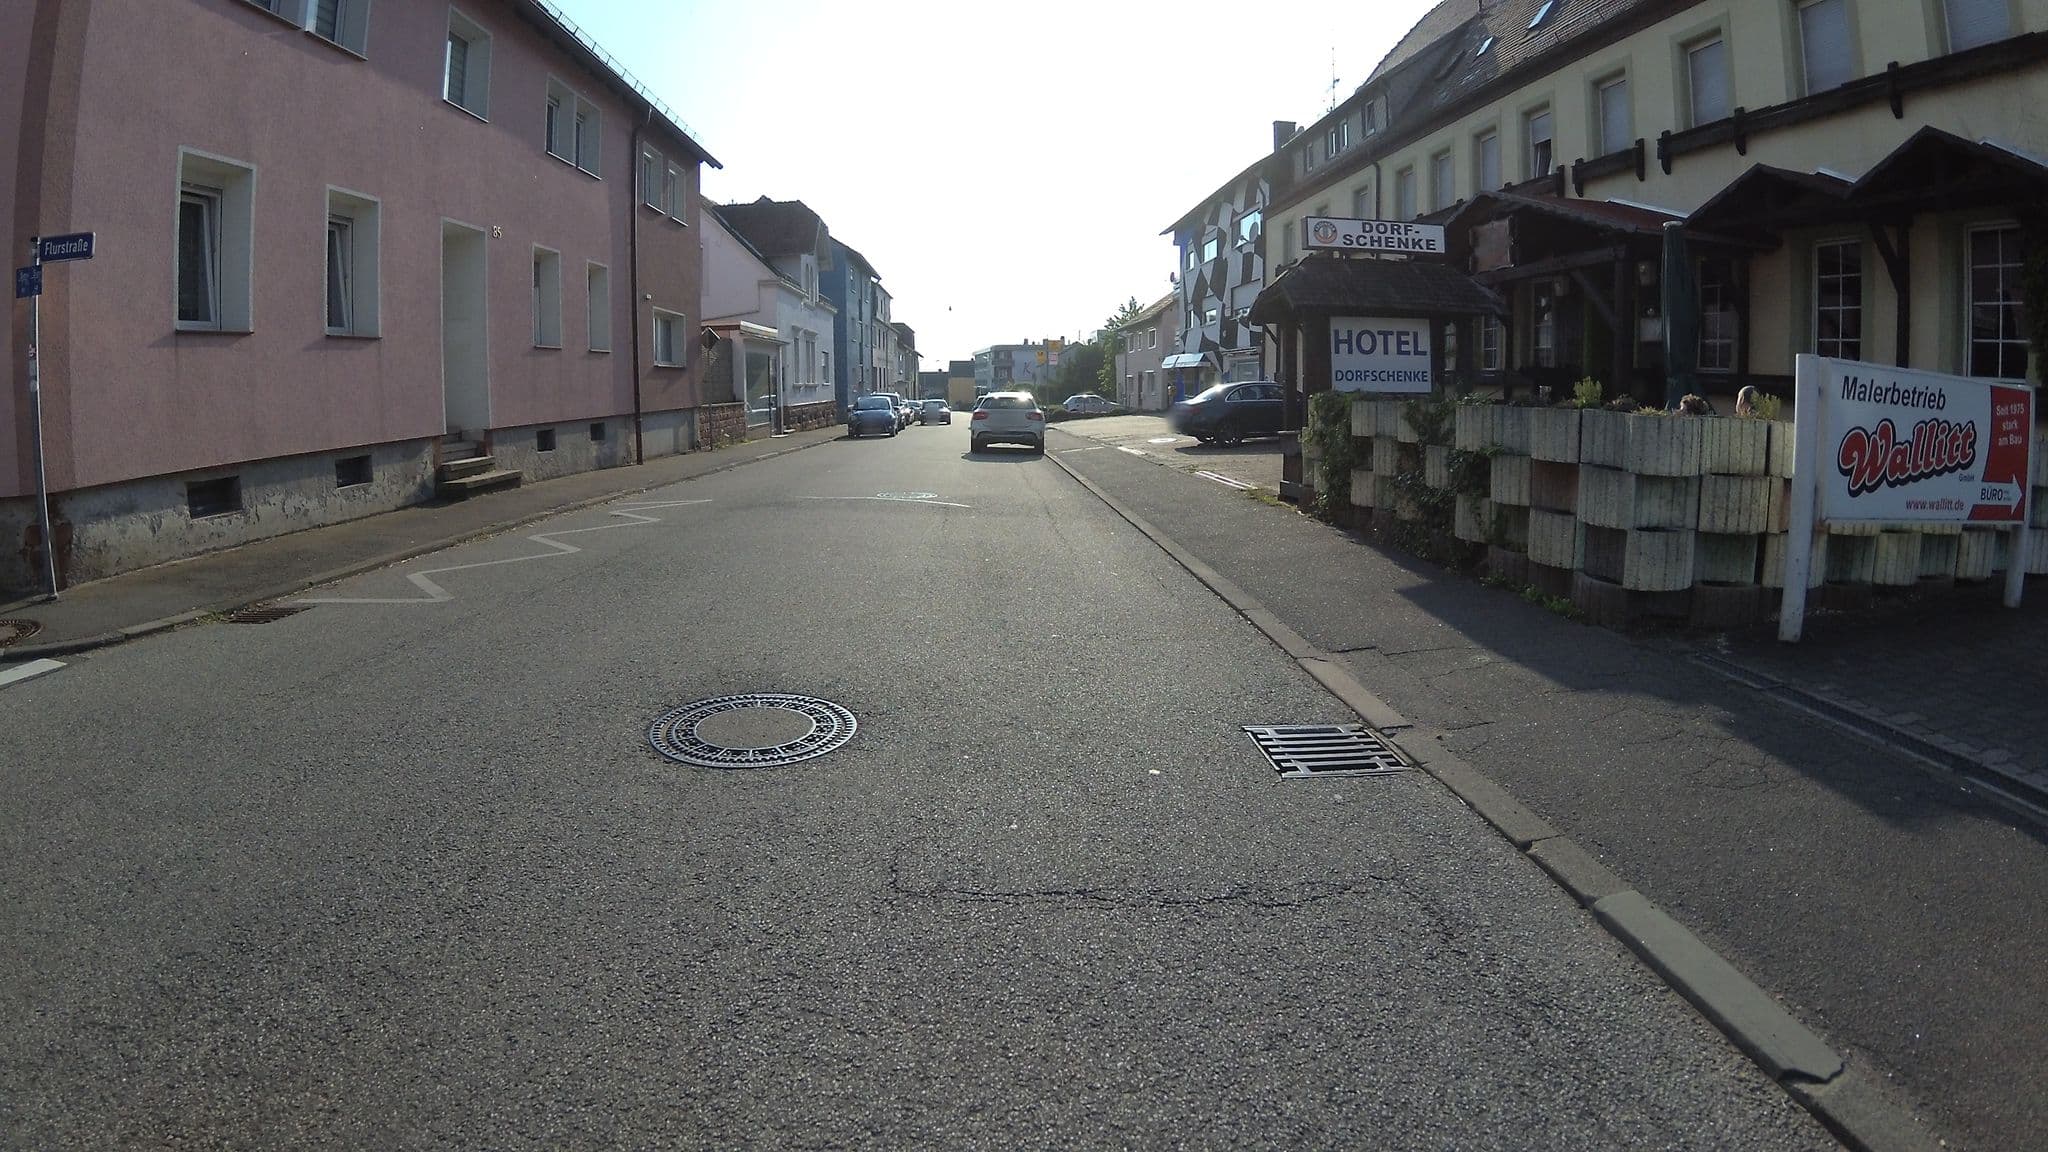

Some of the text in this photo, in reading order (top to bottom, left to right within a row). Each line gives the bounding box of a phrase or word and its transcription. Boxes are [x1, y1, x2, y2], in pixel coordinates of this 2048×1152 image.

[1361, 221, 1421, 236] DORF-
[44, 238, 89, 256] Flurstraße
[1342, 234, 1437, 251] SCHENKE
[1333, 329, 1428, 356] HOTEL
[1335, 369, 1429, 383] DORFSCHENKE
[1841, 375, 1946, 410] Malerbetrieb
[1996, 402, 2025, 416] Seit 1975
[2009, 434, 2023, 446] Bau
[1838, 418, 1977, 498] Wallitt
[1980, 485, 2004, 501] BÜRO
[1905, 498, 1965, 511] www.wallitt.de
